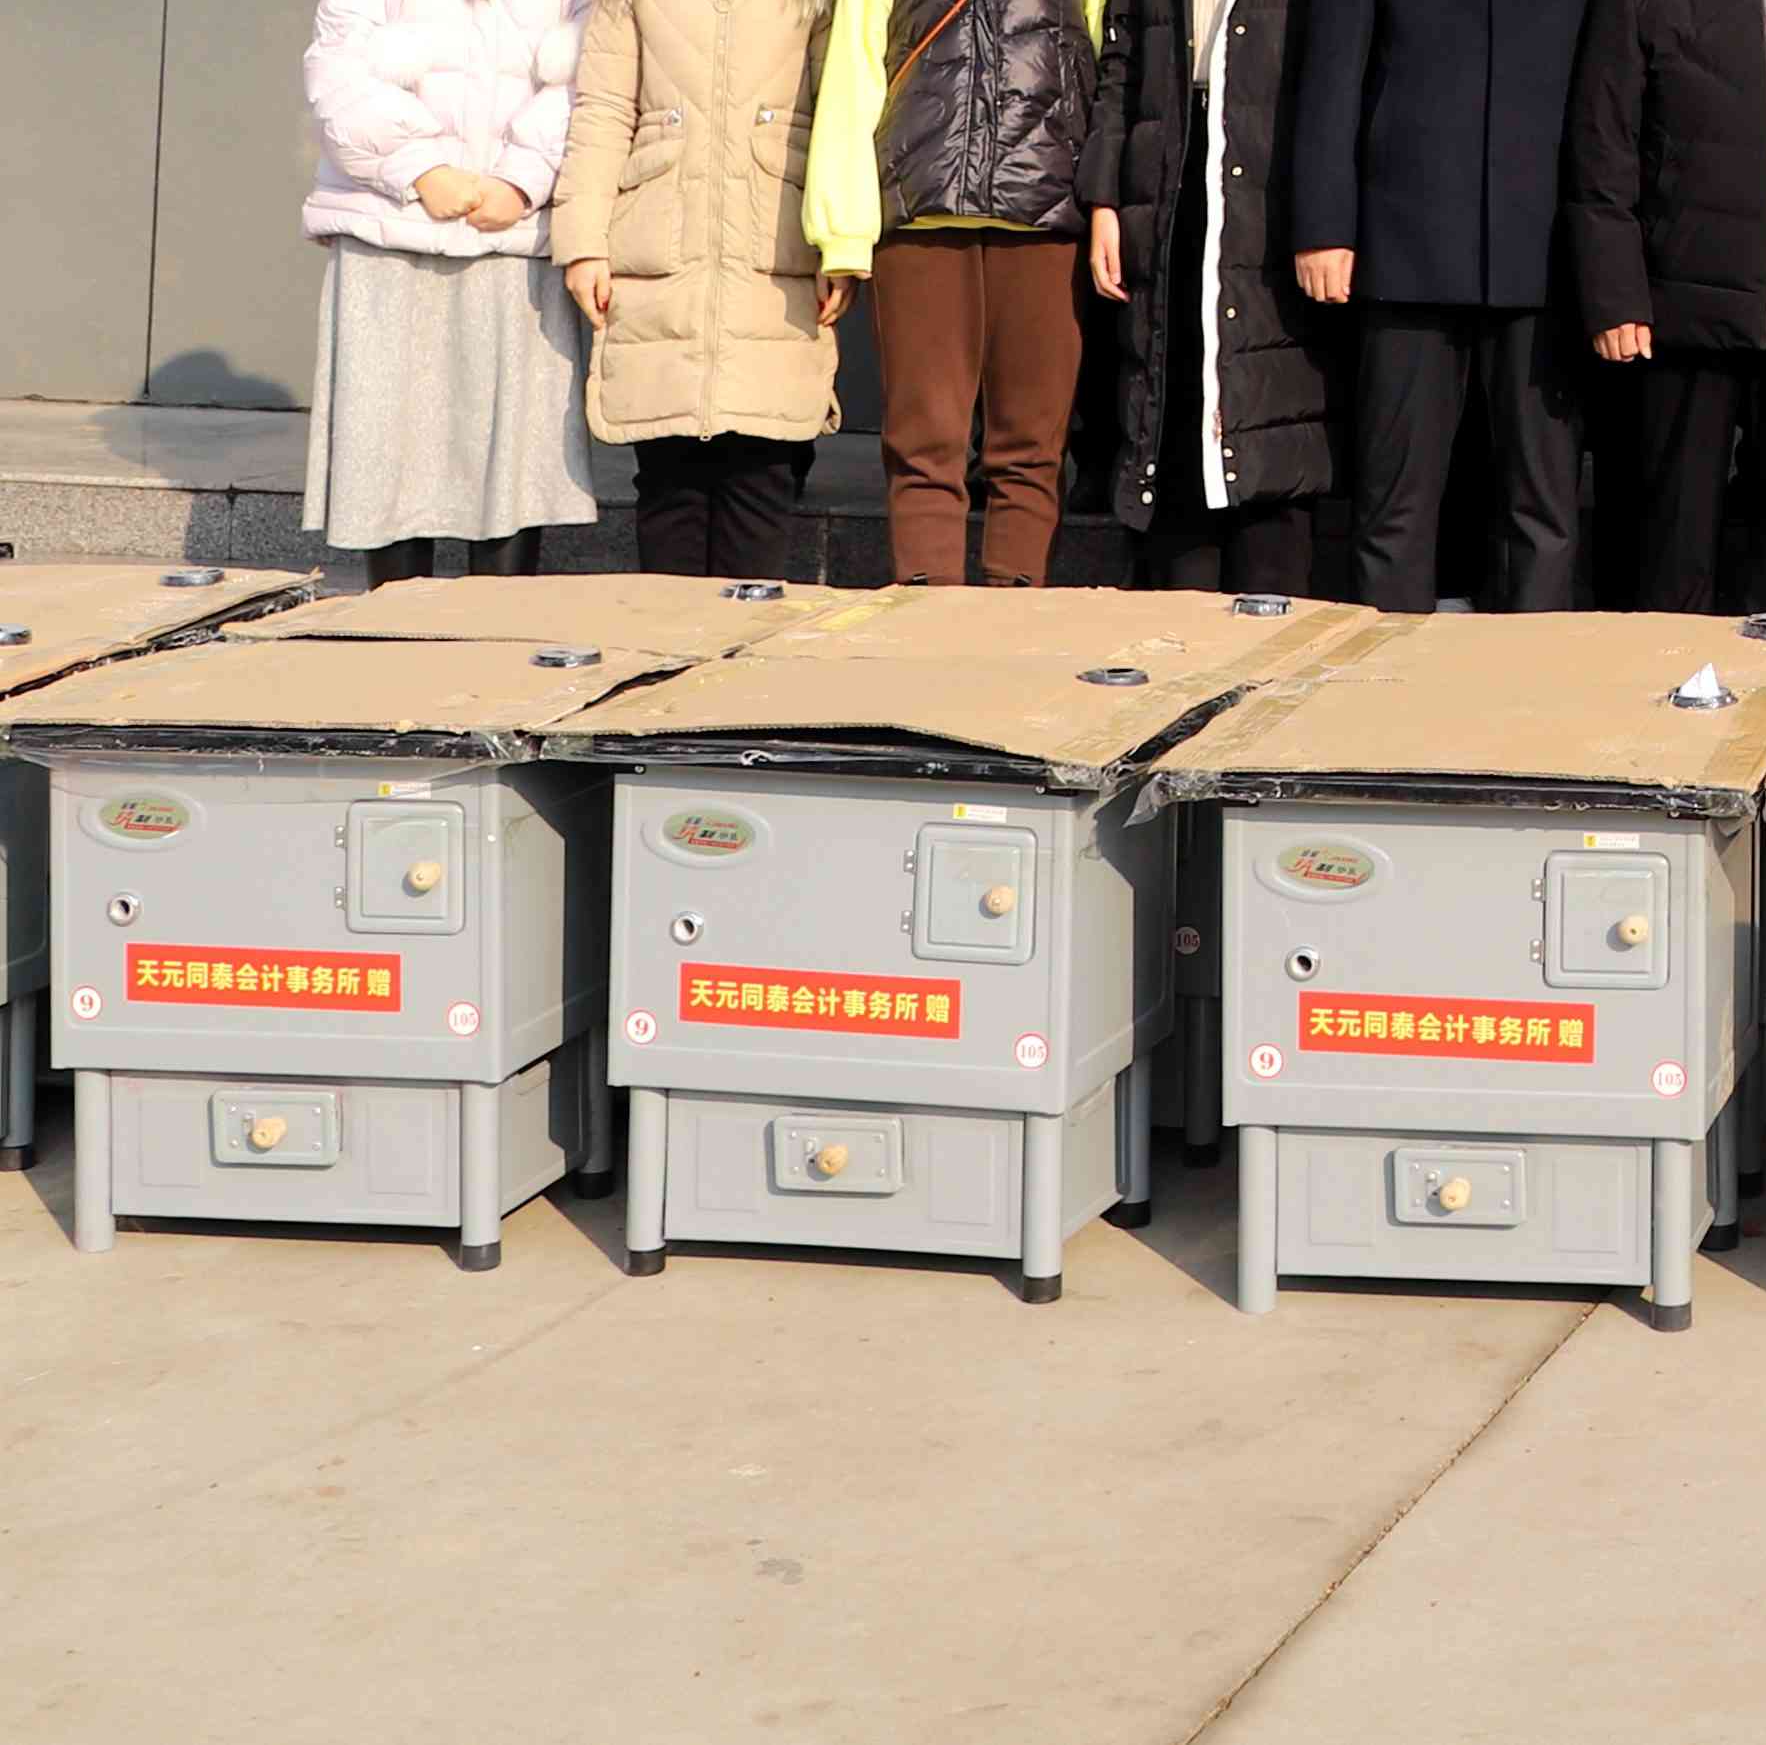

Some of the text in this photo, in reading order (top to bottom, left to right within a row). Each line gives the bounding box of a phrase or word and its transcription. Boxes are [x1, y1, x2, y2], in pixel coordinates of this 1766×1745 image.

[136, 958, 391, 997] 天元同泰会计事务所 赠
[79, 993, 95, 1012] 9
[690, 979, 950, 1023] 天元同泰会计事务所 赠
[452, 1009, 478, 1028] 105
[634, 1018, 650, 1037] 9
[1309, 1007, 1585, 1049] 天元同泰会计事务所 赠
[1019, 1042, 1045, 1061] 105
[1259, 1052, 1275, 1071] 9
[1656, 1070, 1683, 1088] 105
